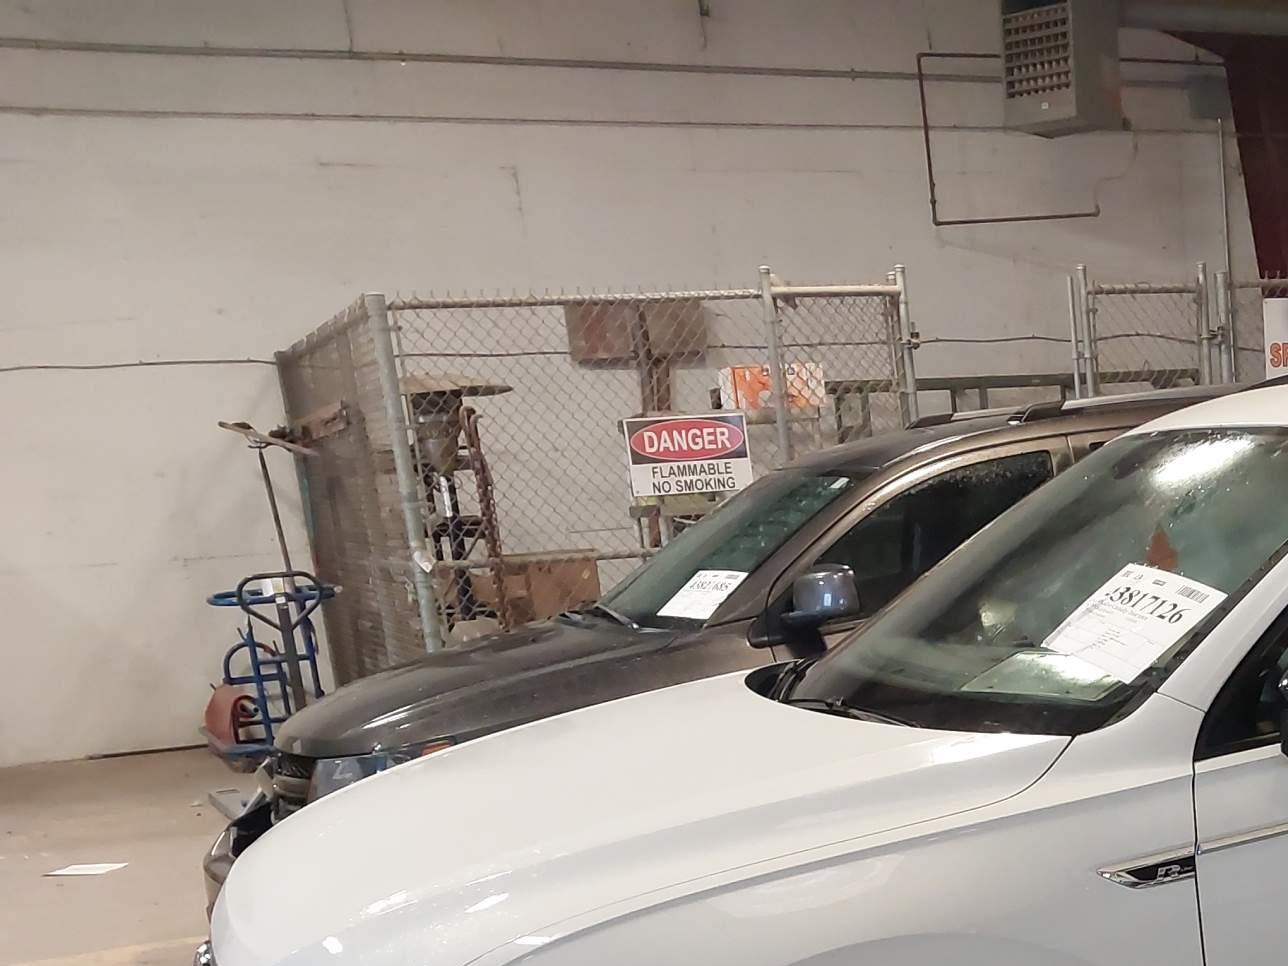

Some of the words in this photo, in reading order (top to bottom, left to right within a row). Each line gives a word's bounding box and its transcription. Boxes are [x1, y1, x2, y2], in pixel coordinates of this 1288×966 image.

[644, 428, 731, 453] DANGER
[651, 461, 733, 479] FLAMMABLE
[652, 480, 672, 494] NO
[675, 476, 737, 493] SMOKING
